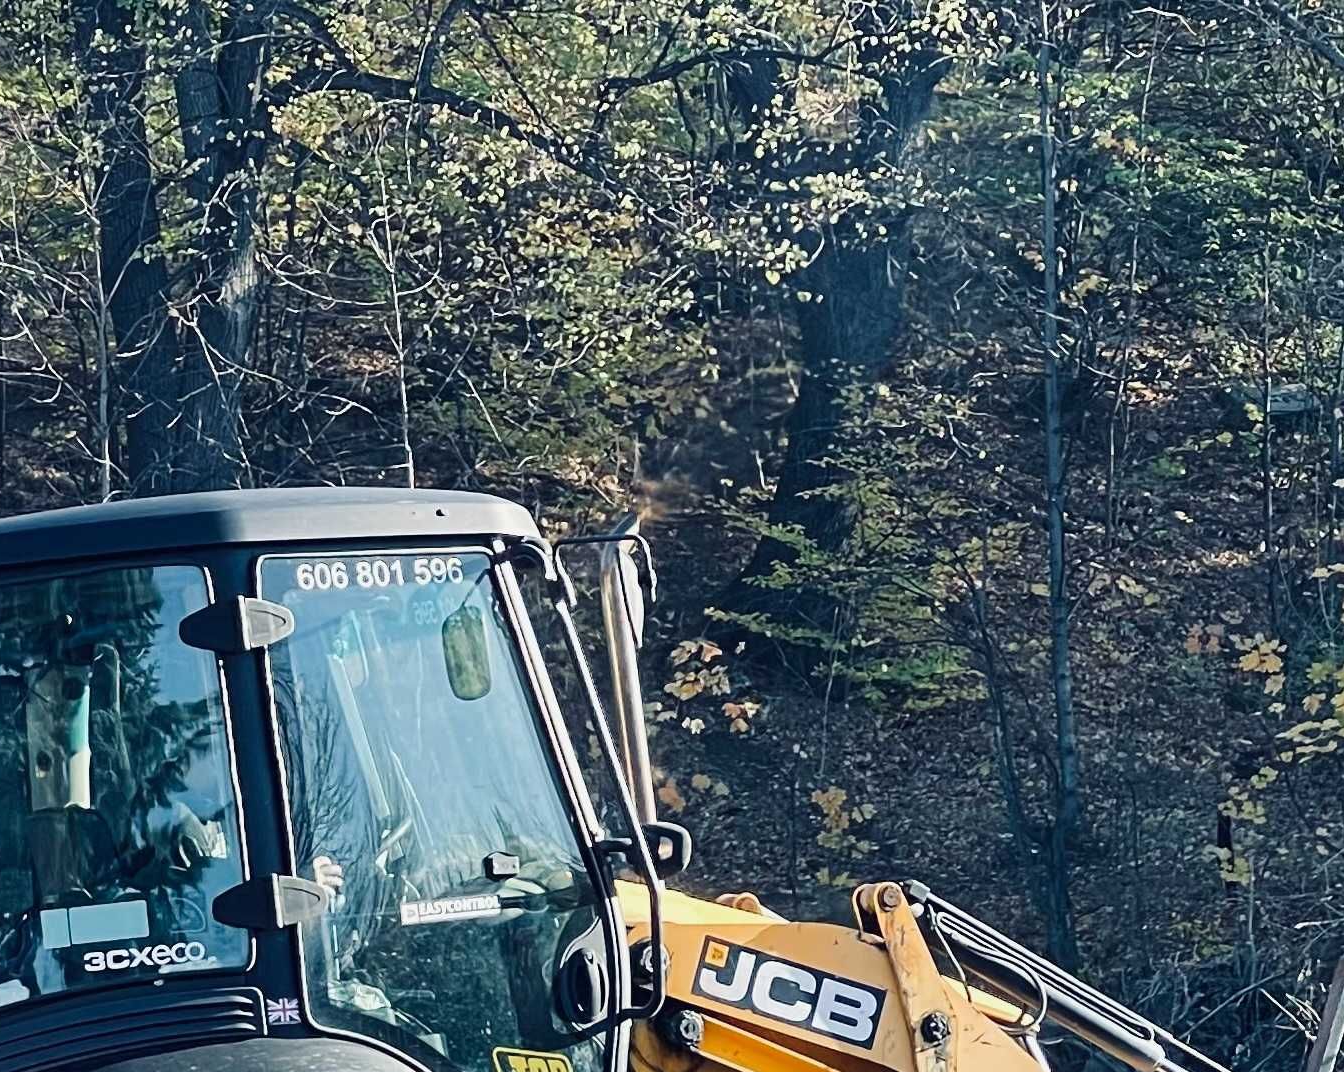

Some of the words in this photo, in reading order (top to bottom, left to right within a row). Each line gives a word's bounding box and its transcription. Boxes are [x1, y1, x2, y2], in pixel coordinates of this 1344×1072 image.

[296, 561, 349, 591] 606
[356, 559, 405, 588] 801
[414, 557, 464, 586] 596
[83, 941, 206, 972] 3CXeco
[698, 950, 878, 1042] JCB
